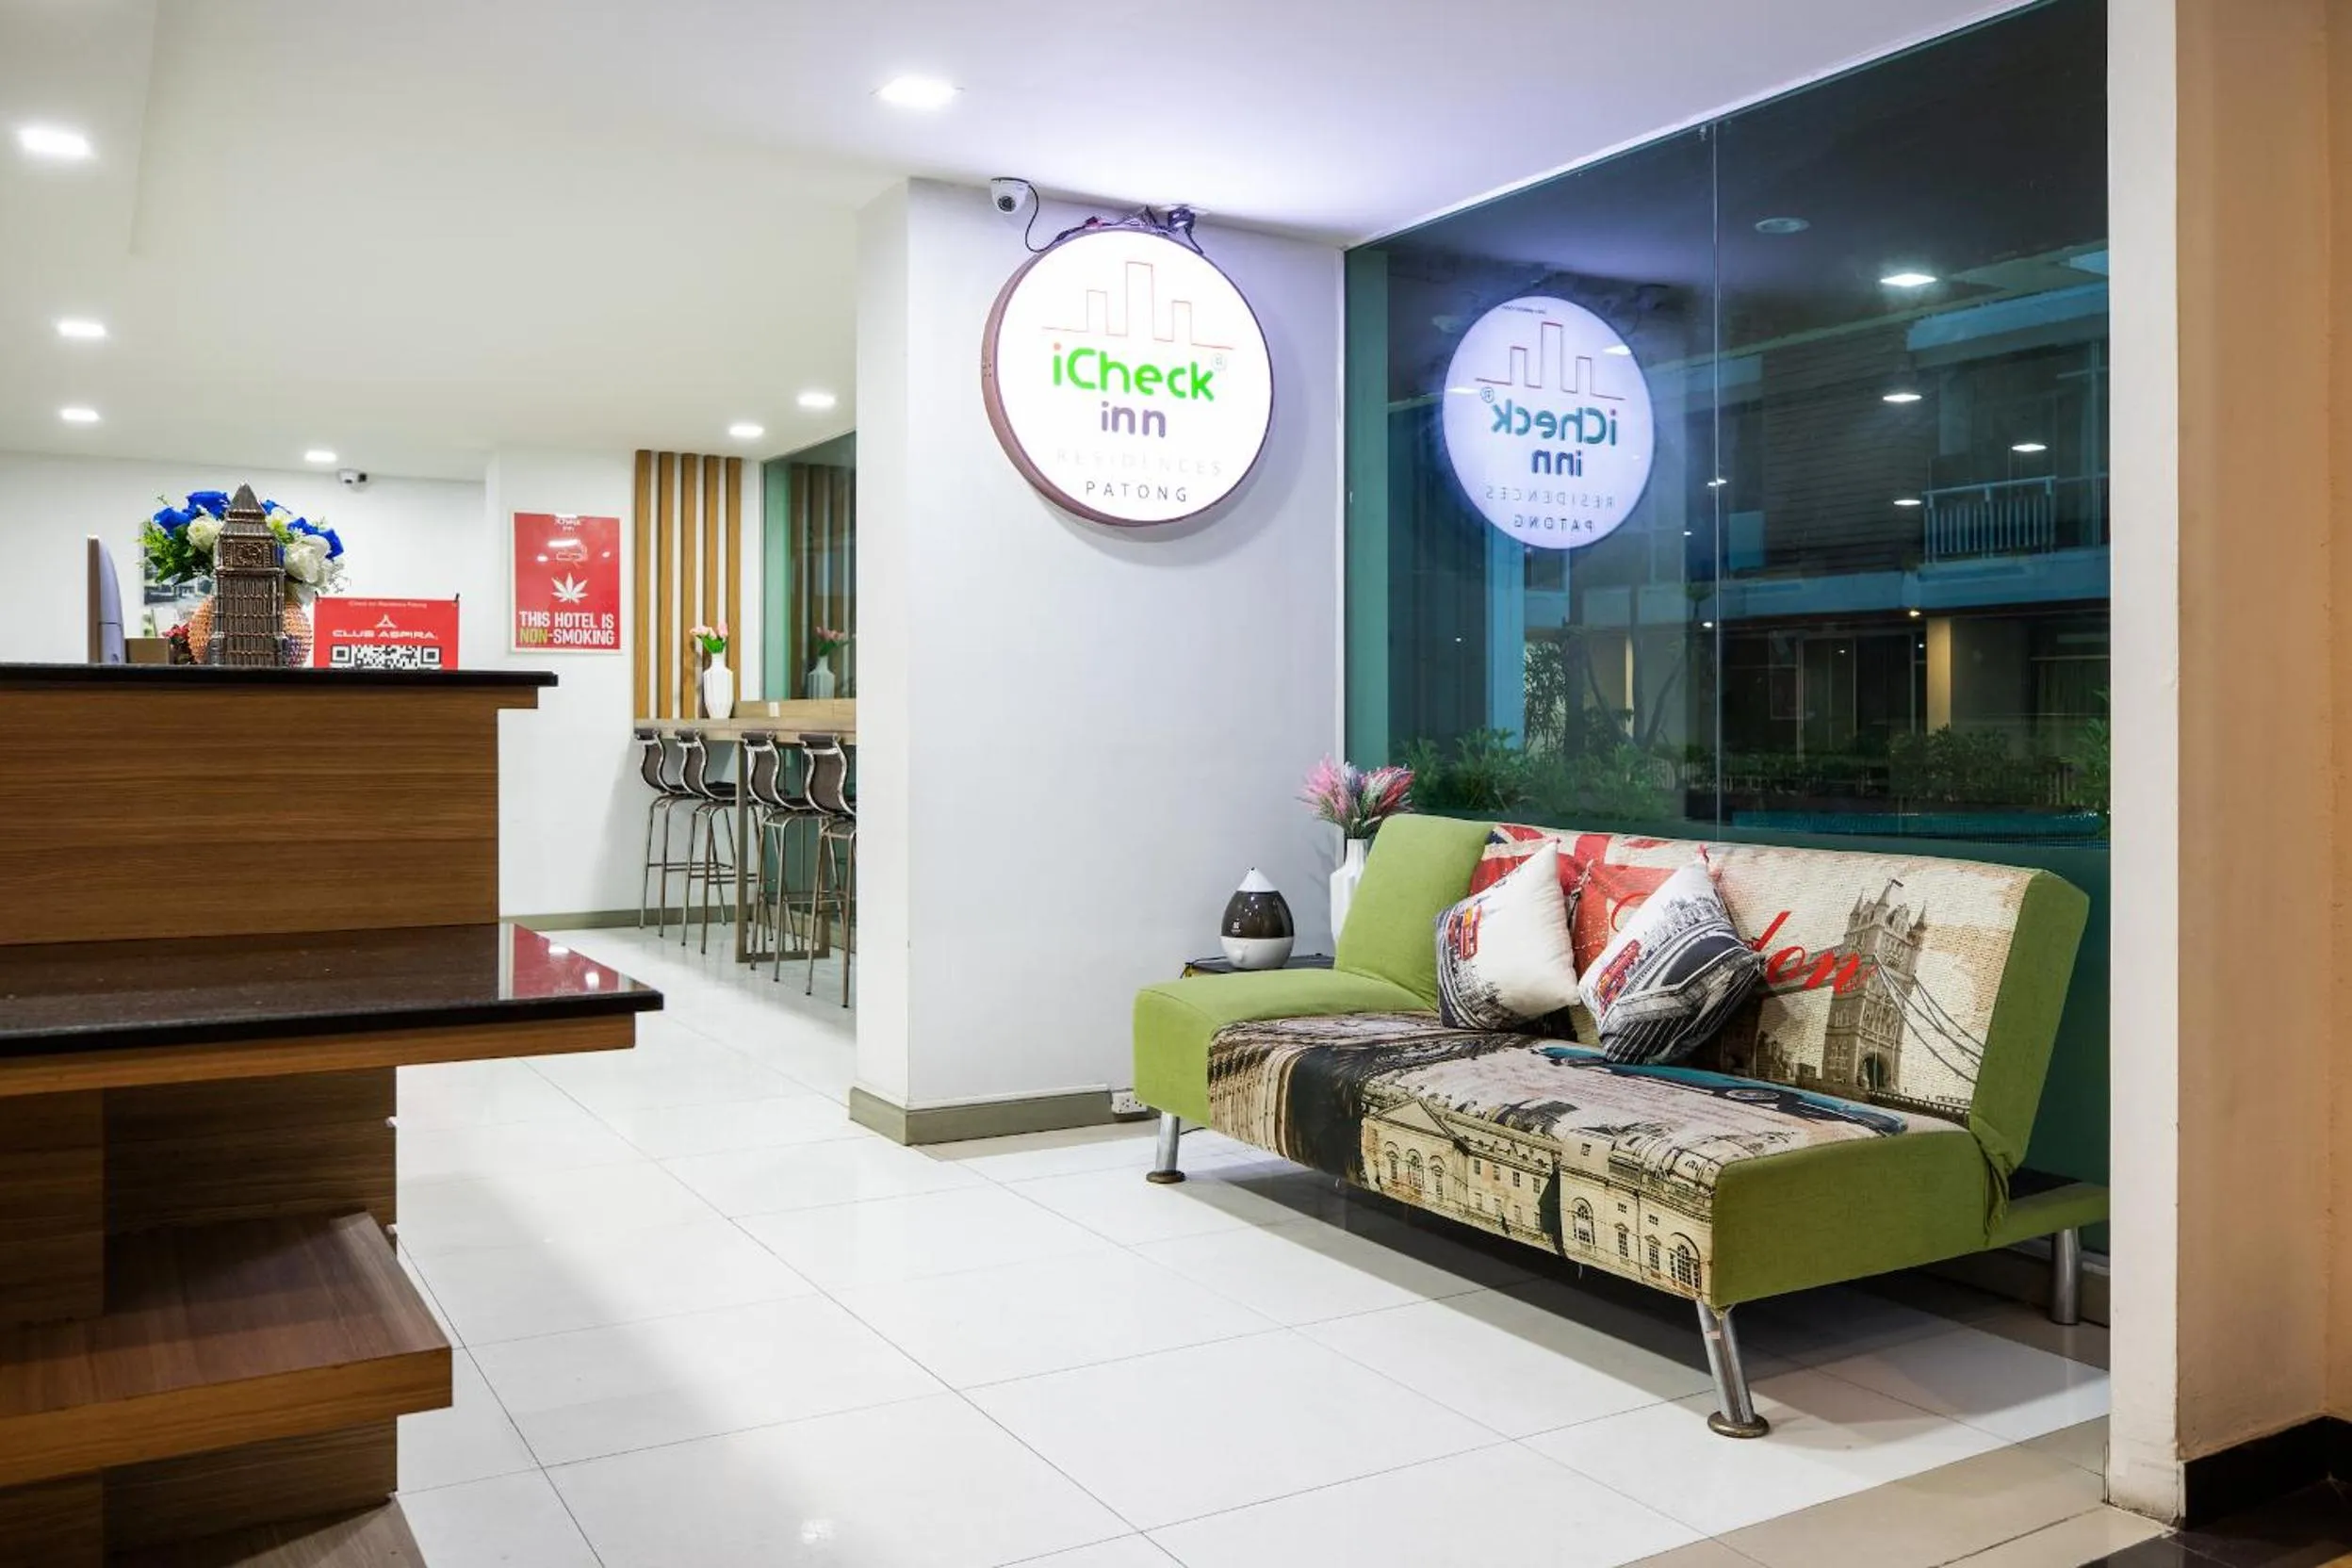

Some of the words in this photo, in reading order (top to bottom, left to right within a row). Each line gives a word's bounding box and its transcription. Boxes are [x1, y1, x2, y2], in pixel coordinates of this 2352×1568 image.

[1052, 342, 1215, 401] iCheck
[1101, 400, 1167, 438] inn
[1086, 481, 1186, 502] PATONG
[519, 611, 550, 628] THIS
[554, 612, 597, 629] HOTEL
[602, 613, 614, 629] IS
[332, 629, 375, 638] CLUB
[520, 628, 614, 645] NON-SMOKING
